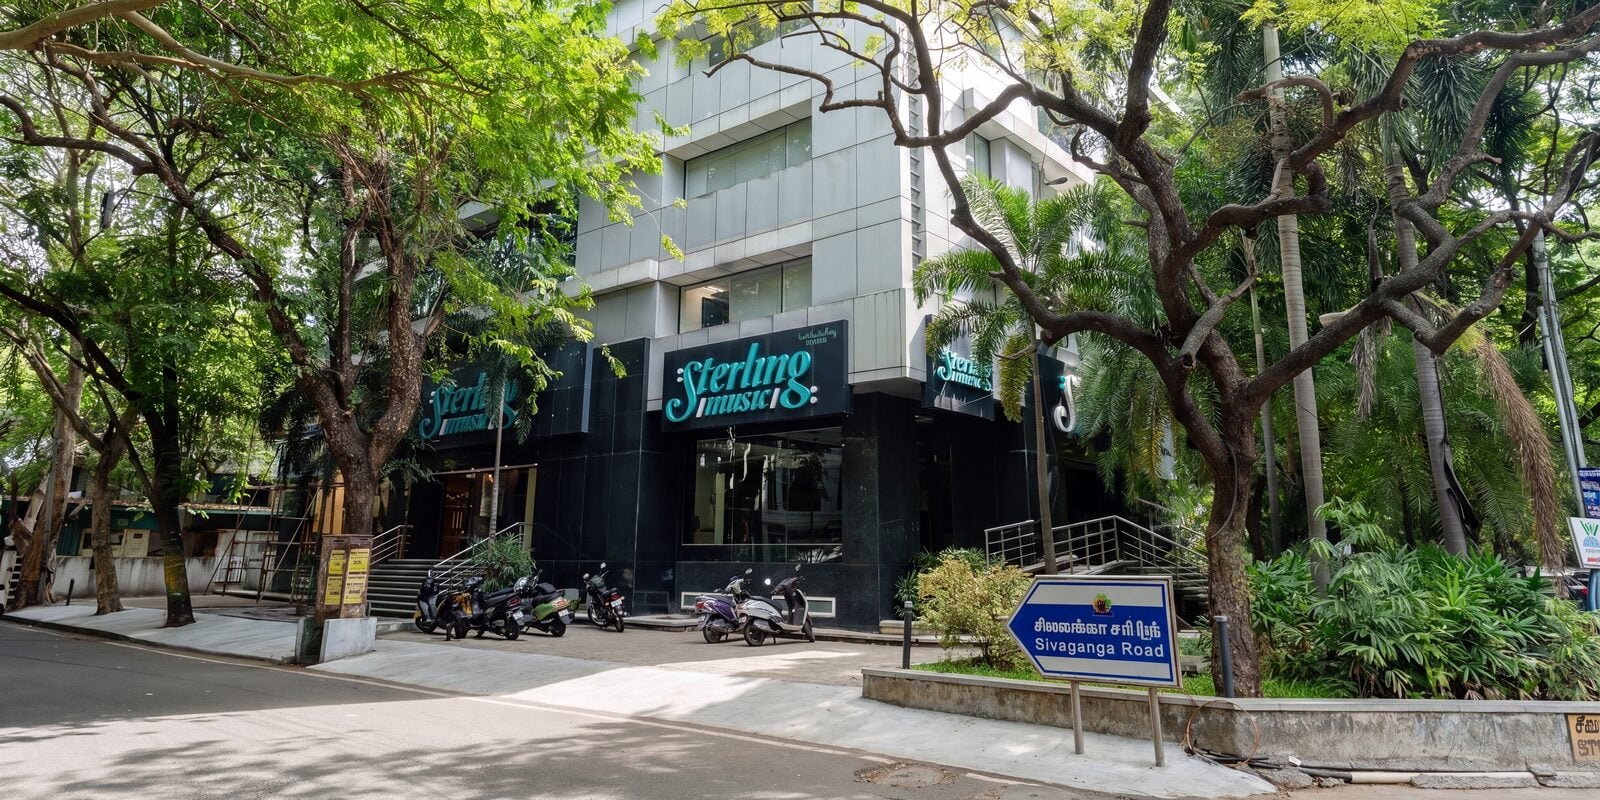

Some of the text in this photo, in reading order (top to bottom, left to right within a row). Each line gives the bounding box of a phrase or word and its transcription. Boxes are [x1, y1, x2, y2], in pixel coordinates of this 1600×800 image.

[665, 342, 812, 422] Sterling
[1035, 638, 1164, 657] Sivaganga Road
